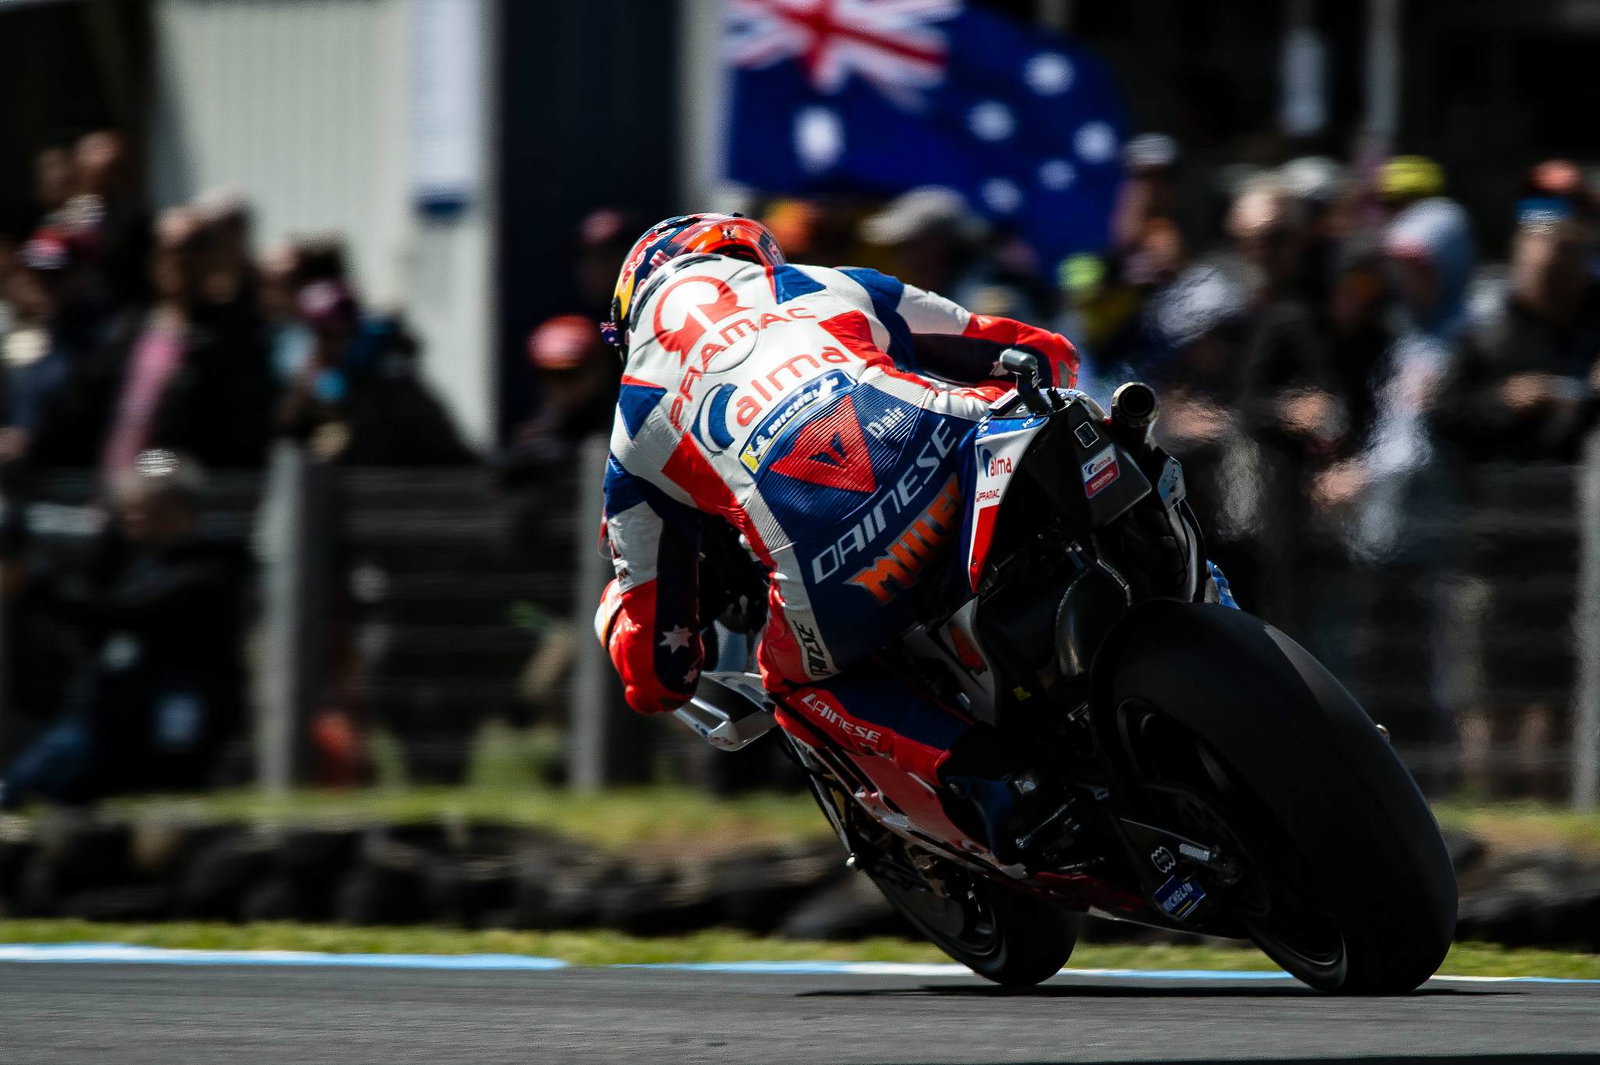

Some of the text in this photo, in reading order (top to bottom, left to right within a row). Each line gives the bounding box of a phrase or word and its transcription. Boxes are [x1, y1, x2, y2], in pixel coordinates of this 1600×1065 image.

[669, 307, 817, 432] PRAMAC
[735, 346, 852, 427] alma
[767, 377, 839, 436] MICHELN
[811, 418, 957, 585] DAINESE
[990, 457, 1012, 476] alma
